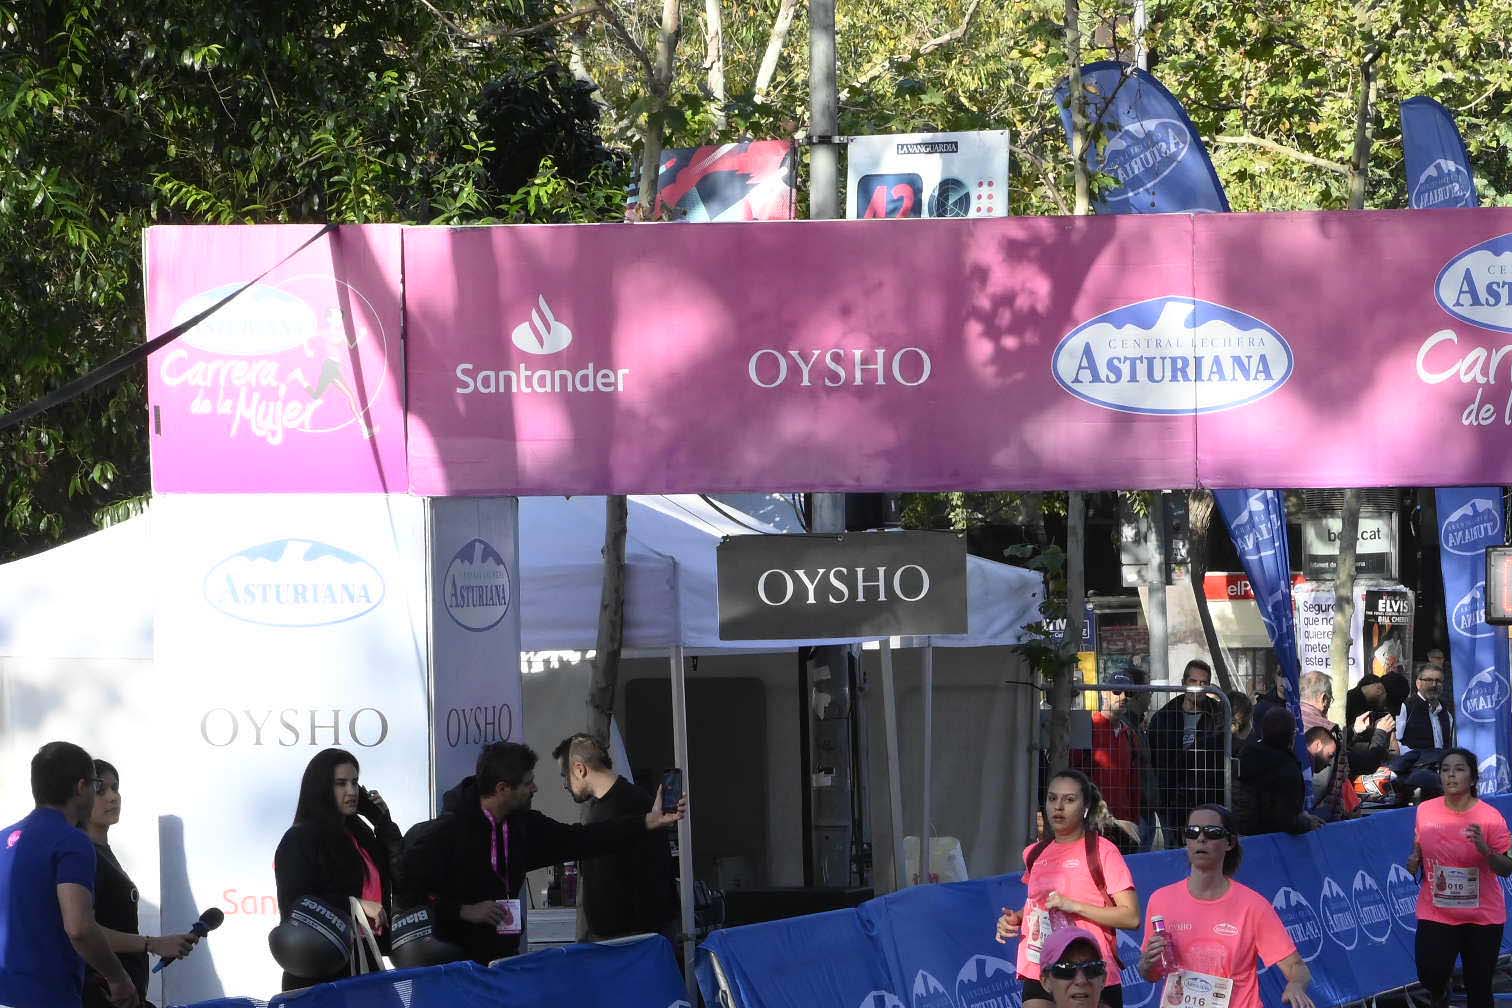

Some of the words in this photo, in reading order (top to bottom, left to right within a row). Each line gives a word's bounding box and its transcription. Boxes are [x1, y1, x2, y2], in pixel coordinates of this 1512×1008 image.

[1108, 337, 1180, 351] CENTRAL
[1189, 335, 1265, 350] LECHERA
[160, 354, 278, 388] Carrera
[456, 361, 631, 395] Santander
[748, 346, 932, 388] OYSHO
[1071, 341, 1275, 385] ASTURIANA
[229, 378, 318, 446] Mujer
[1461, 389, 1497, 428] de
[1327, 527, 1381, 543] b.cat
[224, 572, 373, 606] ASTURIANA
[450, 574, 507, 608] ASTURIANA
[757, 563, 931, 607] OYSHO
[1303, 617, 1320, 628] que
[1378, 599, 1409, 613] ELVIS
[1304, 630, 1336, 642] quiere
[199, 706, 389, 748] OYSHO
[447, 703, 512, 748] OYSHO
[300, 897, 347, 934] Blauer
[1184, 995, 1205, 1007] 016
